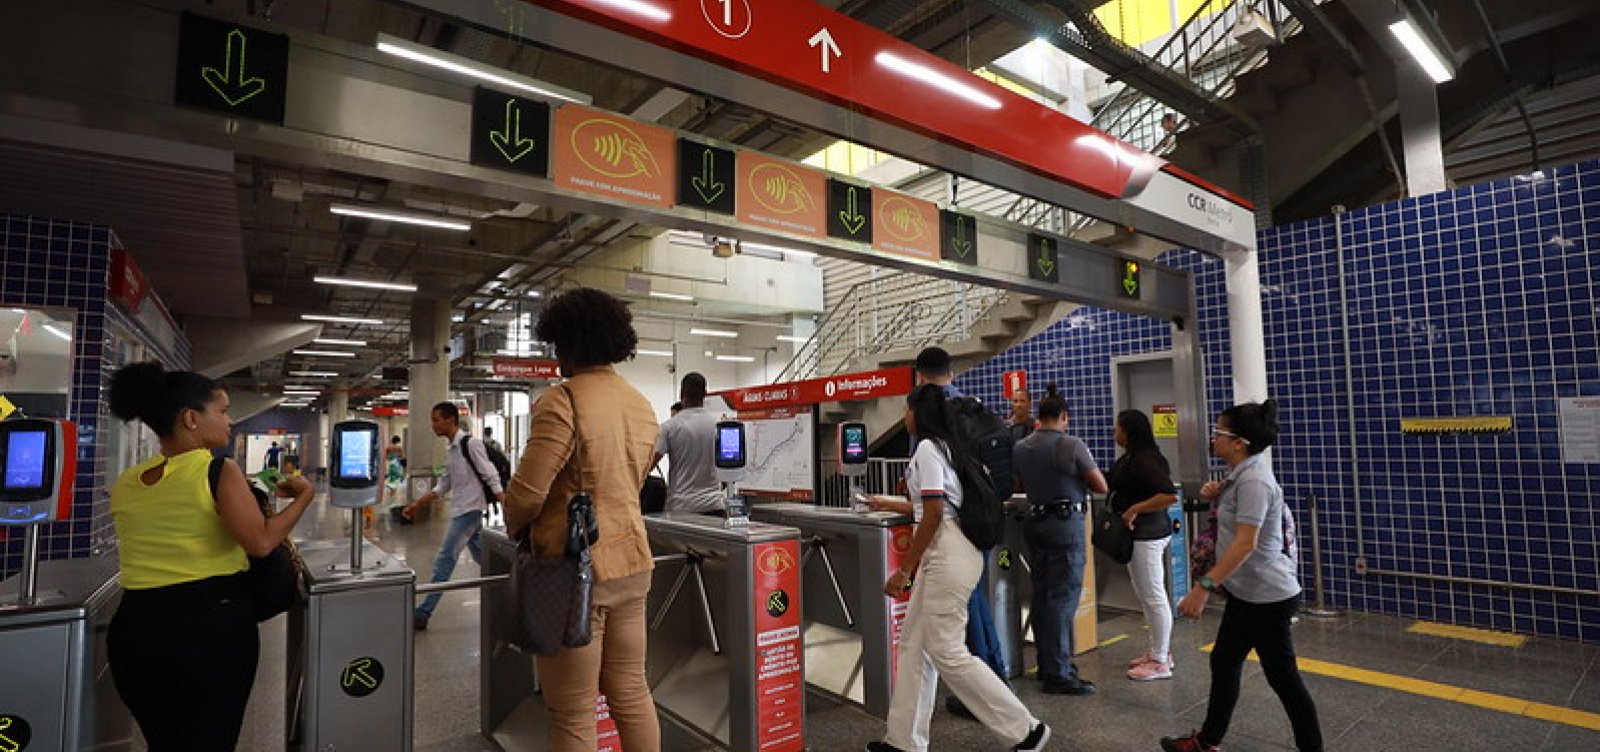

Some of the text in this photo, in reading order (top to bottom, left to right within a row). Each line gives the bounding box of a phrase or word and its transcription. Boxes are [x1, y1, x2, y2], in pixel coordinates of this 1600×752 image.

[718, 0, 732, 26] 1
[1187, 192, 1207, 213] CCR
[837, 375, 887, 391] Informações
